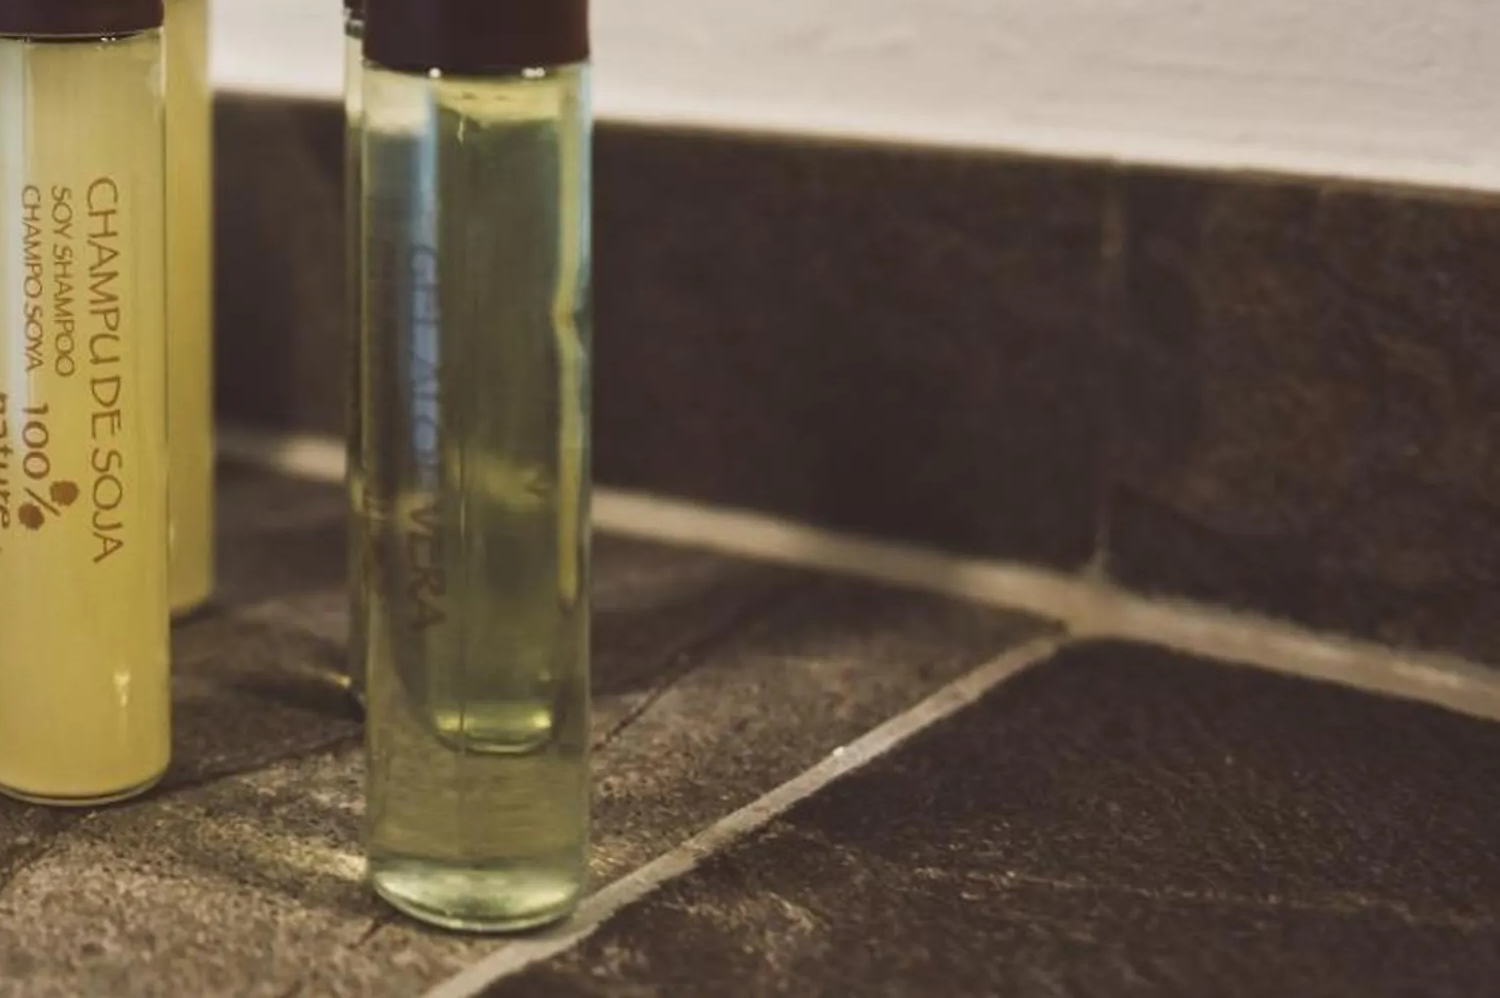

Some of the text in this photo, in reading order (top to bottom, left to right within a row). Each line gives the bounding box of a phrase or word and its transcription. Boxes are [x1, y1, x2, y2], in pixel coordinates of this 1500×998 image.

[21, 184, 44, 372] CHAMPO SOYA
[51, 184, 75, 378] SOY SHAMPOO
[87, 176, 124, 564] CHAMPU DE SOJA
[17, 403, 80, 531] 100%
